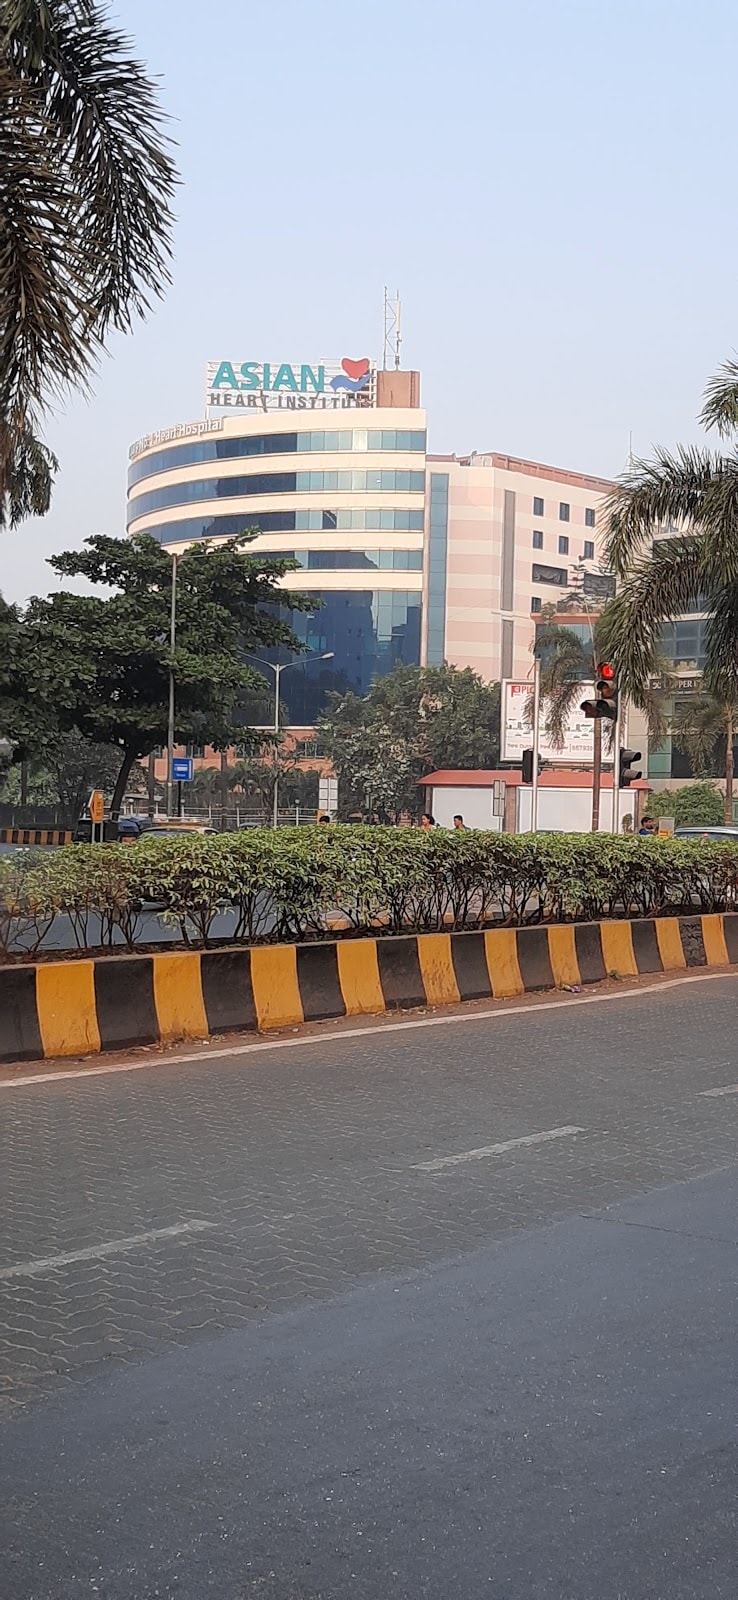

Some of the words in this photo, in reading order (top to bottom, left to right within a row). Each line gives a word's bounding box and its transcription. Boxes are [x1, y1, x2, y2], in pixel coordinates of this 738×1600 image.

[211, 361, 326, 392] ASIAN
[210, 393, 269, 411] HEART
[178, 418, 222, 437] Hospital
